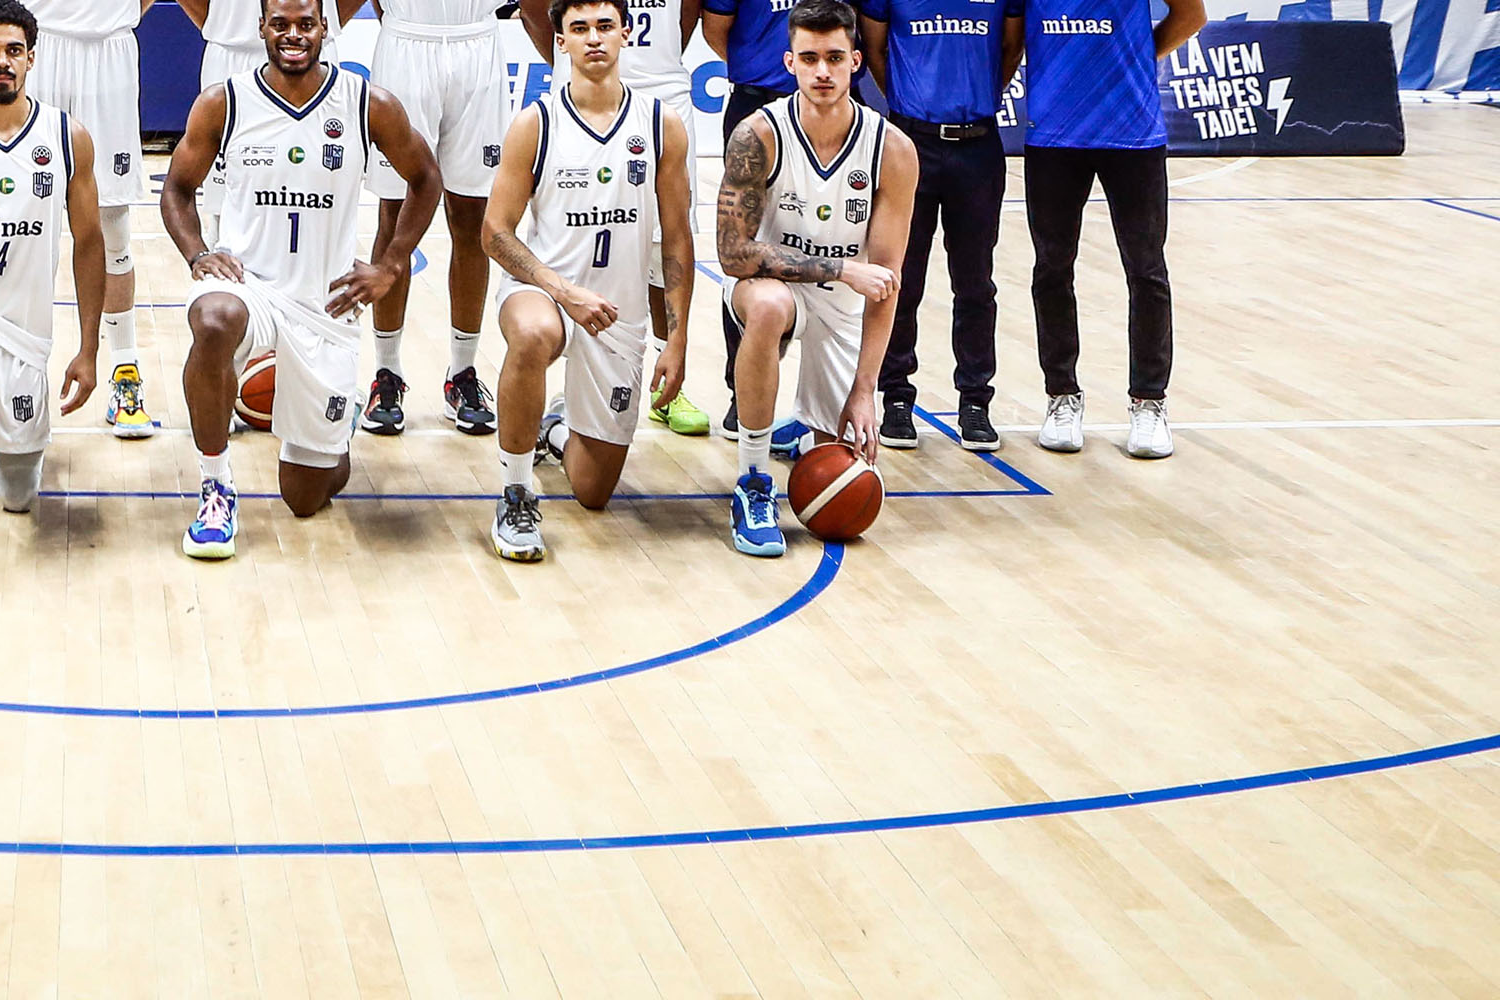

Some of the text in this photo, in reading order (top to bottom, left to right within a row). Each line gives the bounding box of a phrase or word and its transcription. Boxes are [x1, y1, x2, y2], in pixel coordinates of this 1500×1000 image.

[910, 14, 989, 35] minas
[1042, 15, 1112, 34] minas
[1208, 41, 1265, 79] VEM
[1169, 77, 1263, 111] TEMPES
[1193, 106, 1259, 141] TADE!
[243, 158, 274, 166] icone
[255, 186, 334, 209] minas
[565, 206, 638, 227] minas
[288, 212, 300, 253] 1
[780, 231, 859, 259] minas
[592, 228, 612, 268] 0
